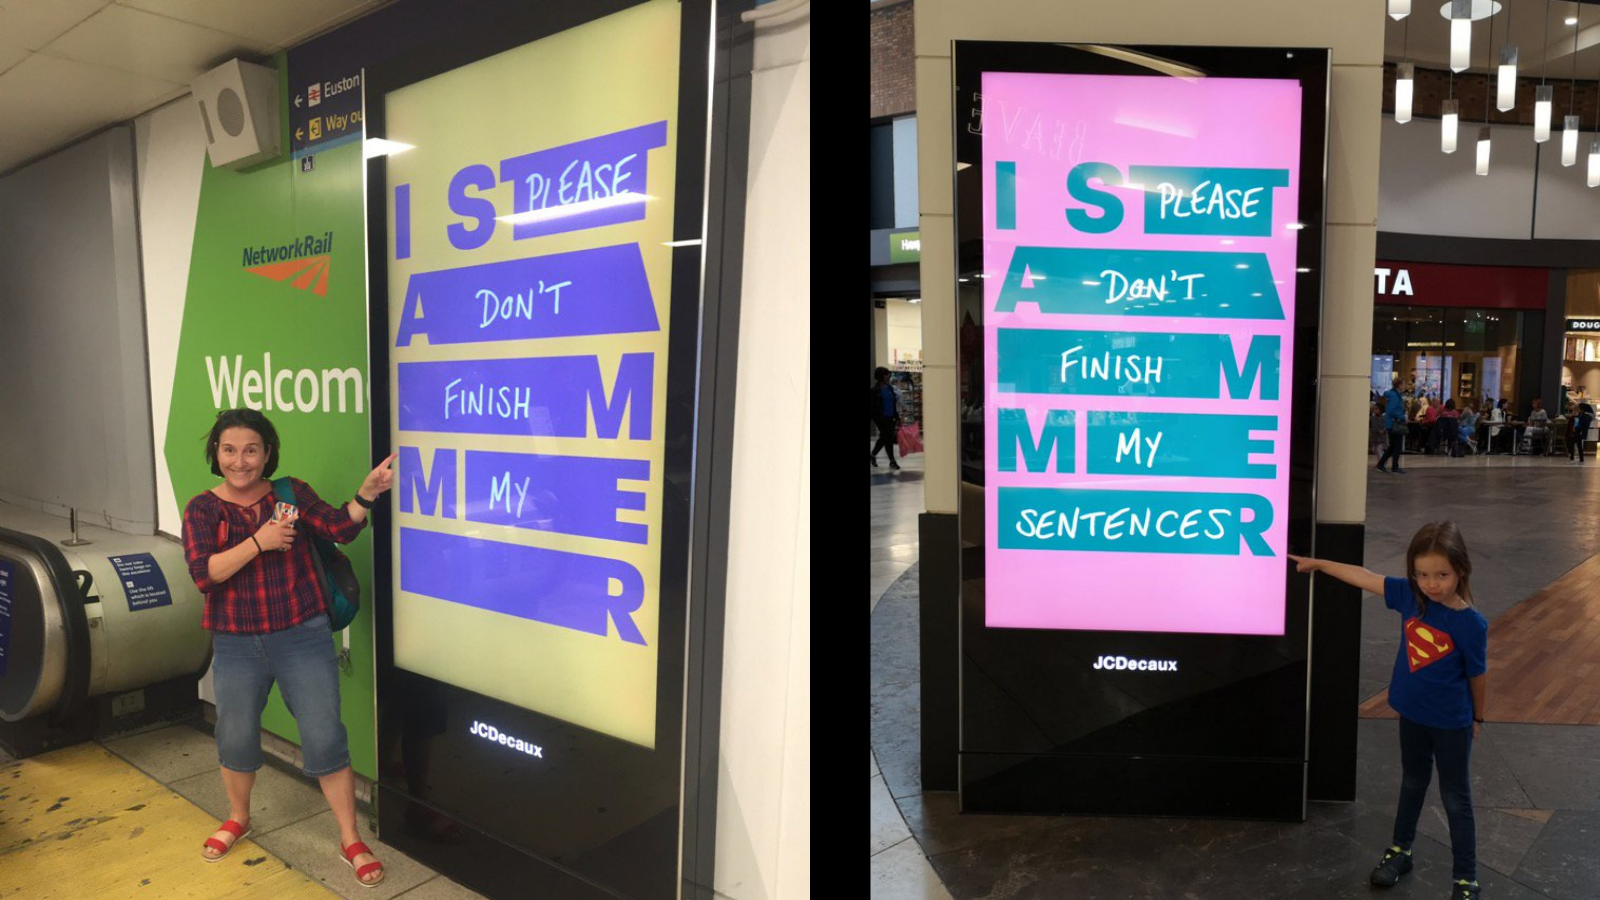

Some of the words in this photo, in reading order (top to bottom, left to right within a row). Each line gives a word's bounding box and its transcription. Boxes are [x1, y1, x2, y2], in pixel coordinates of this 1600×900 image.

[324, 75, 360, 98] Euston
[326, 114, 348, 131] Way
[525, 153, 638, 212] PLEASE
[995, 161, 1017, 230] I
[1157, 179, 1265, 220] PLEASE
[395, 183, 411, 260] I
[475, 280, 572, 328] DON'T
[1100, 269, 1205, 304] DON'T
[205, 352, 371, 413] Welcom
[1060, 345, 1164, 384] FINISH
[444, 378, 531, 420] FINISH
[1115, 427, 1163, 469] MY
[489, 471, 530, 519] MY
[1015, 506, 1232, 541] SENTENCES
[1092, 655, 1178, 672] JCDecaux
[469, 720, 543, 759] JCDecaux
